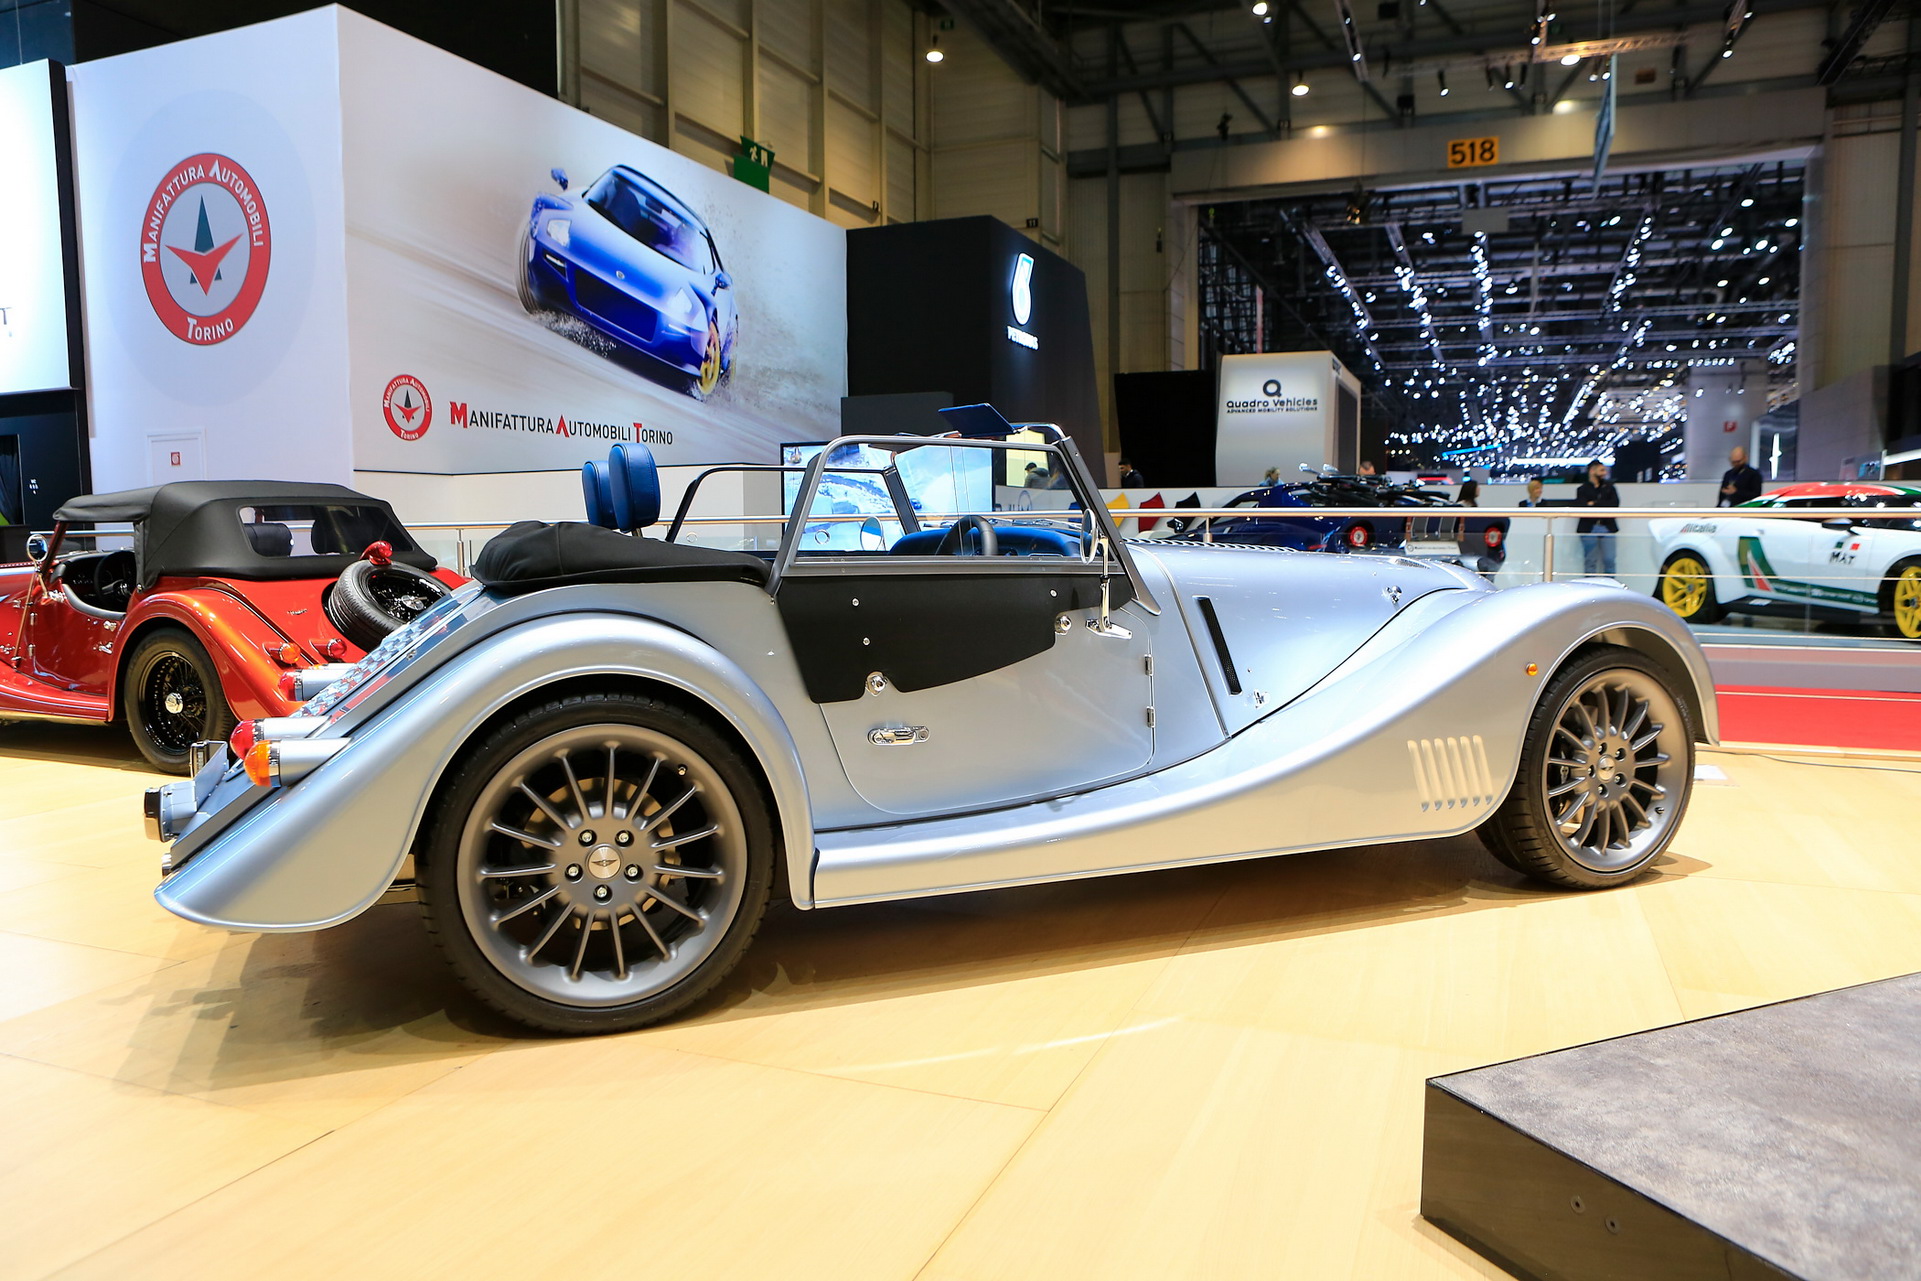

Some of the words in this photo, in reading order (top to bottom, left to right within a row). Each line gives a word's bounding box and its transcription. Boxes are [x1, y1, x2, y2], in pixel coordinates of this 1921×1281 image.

[1451, 139, 1495, 165] 518
[143, 163, 206, 263] MANIFATTURA
[208, 159, 264, 247] AUTOMOBILI
[187, 316, 234, 341] TORINO
[1272, 397, 1318, 407] Vehicles
[450, 401, 554, 434] MANIFATTURA
[555, 415, 631, 441] AUTOMOBILI
[633, 422, 673, 445] TORINO
[1829, 552, 1856, 565] MAT
